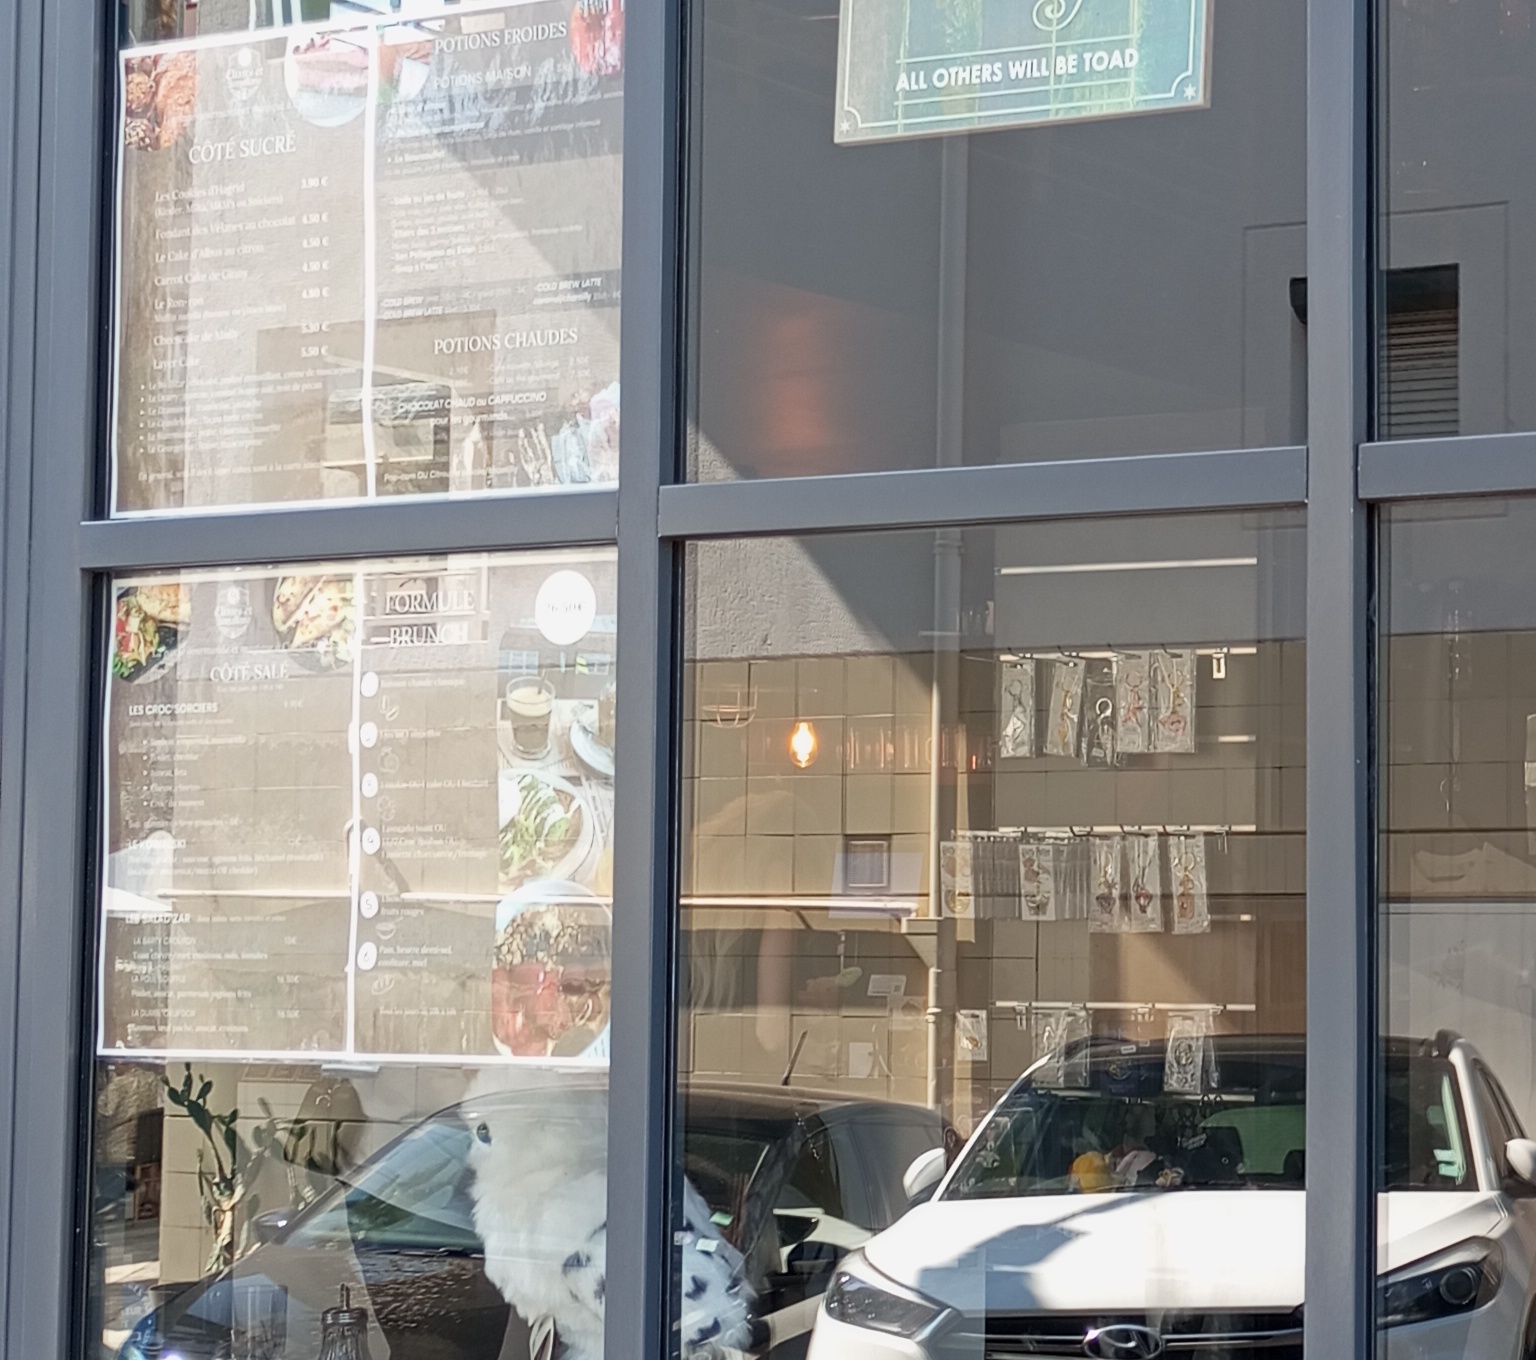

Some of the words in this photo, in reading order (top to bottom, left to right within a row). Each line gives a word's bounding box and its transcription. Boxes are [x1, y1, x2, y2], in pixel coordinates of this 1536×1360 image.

[435, 30, 501, 54] POTIONS
[896, 71, 927, 91] ALL
[933, 62, 1002, 87] OTHERS
[1008, 57, 1049, 80] WILL
[1055, 54, 1077, 76] BE
[1083, 47, 1139, 73] TOAD
[189, 137, 235, 165] CÔTÉ
[240, 130, 297, 158] SUCRÉ
[434, 335, 500, 354] POTIONS
[504, 328, 578, 349] CHAUDES
[488, 391, 547, 406] CAPPUCCINO
[385, 590, 475, 614] FORMULE
[390, 621, 468, 647] BRUNCH
[210, 662, 249, 682] CÔTÉ
[253, 658, 289, 680] SALÉ
[129, 705, 143, 716] LES
